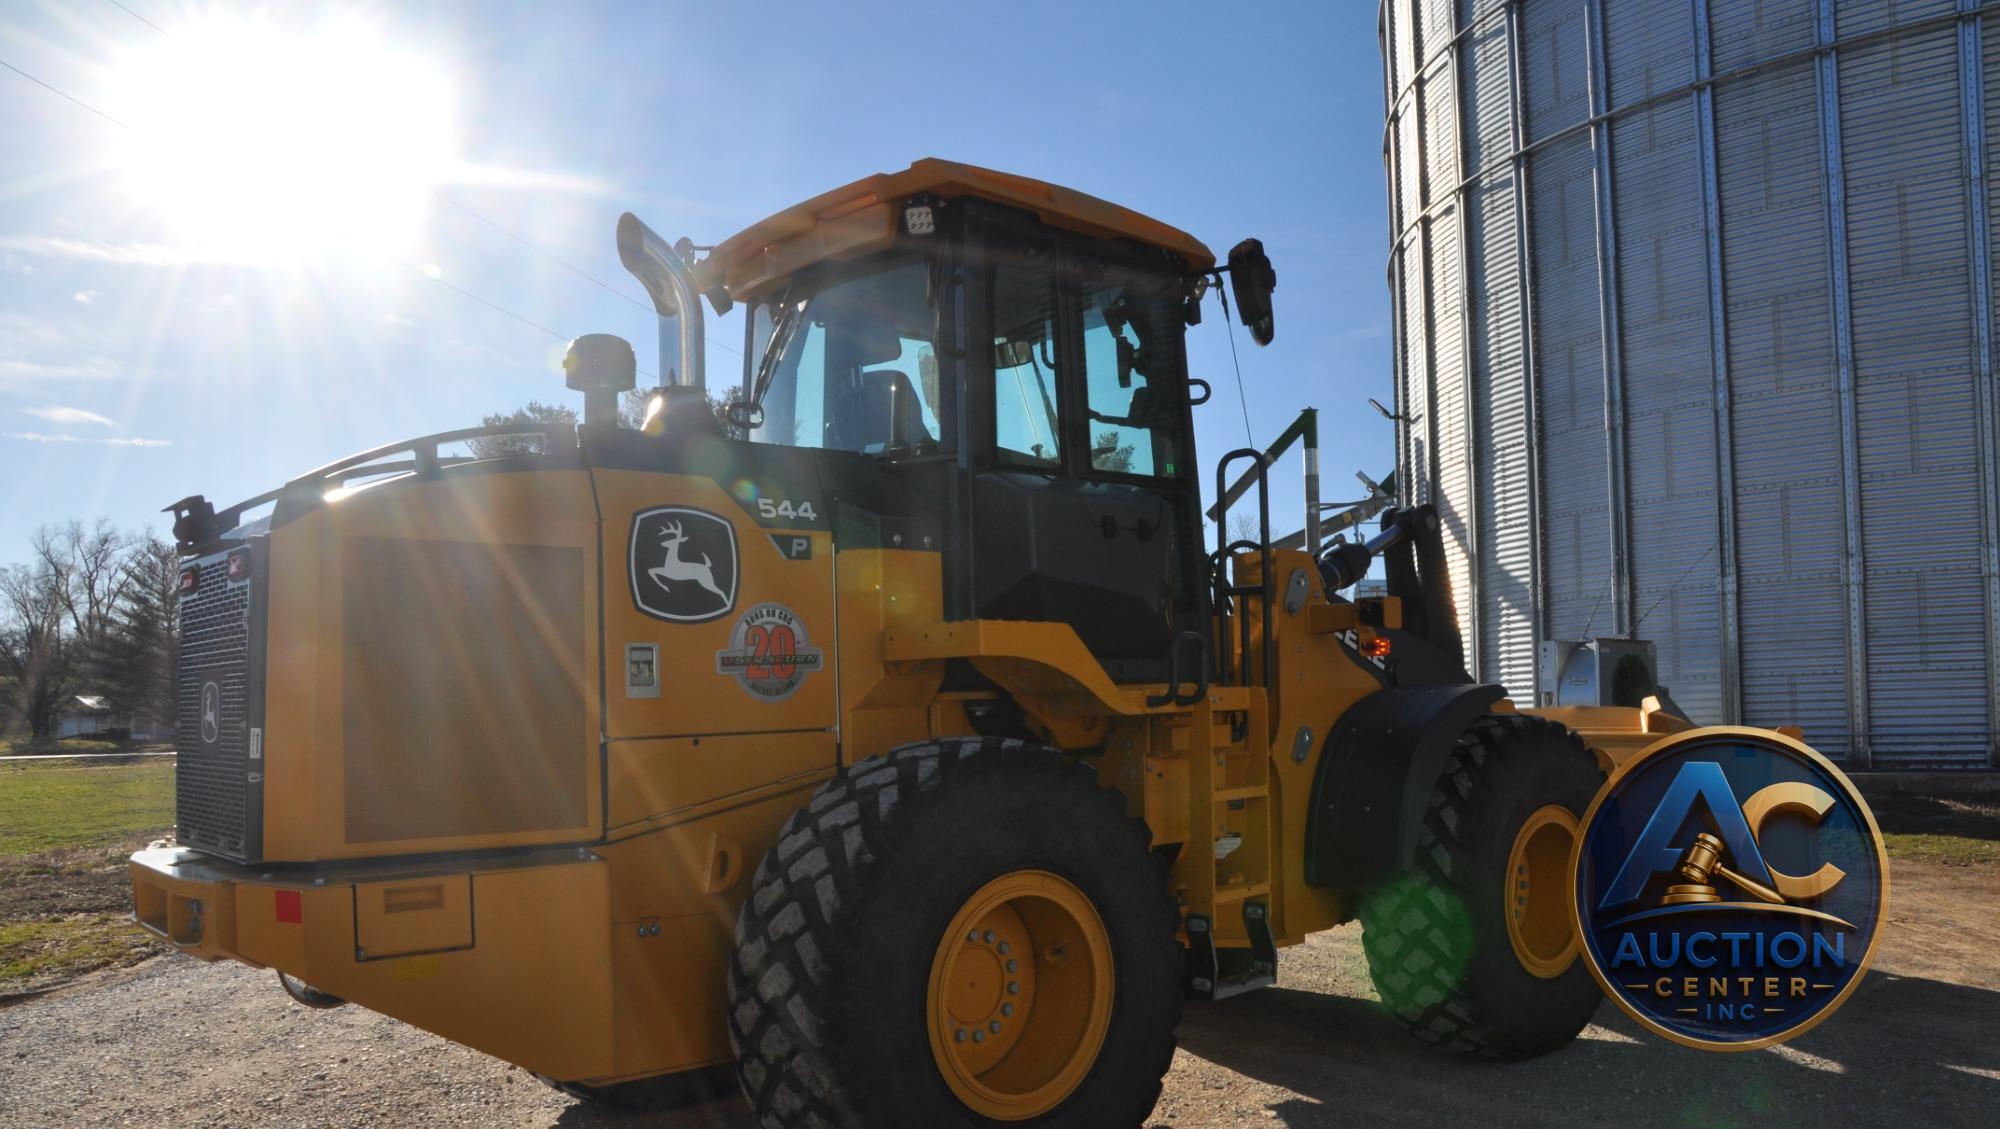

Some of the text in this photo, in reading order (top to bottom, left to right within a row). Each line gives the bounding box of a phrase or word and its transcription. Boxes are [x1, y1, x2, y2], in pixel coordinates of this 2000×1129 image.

[758, 498, 817, 521] 544
[791, 538, 808, 556] P
[744, 625, 796, 680] 20
